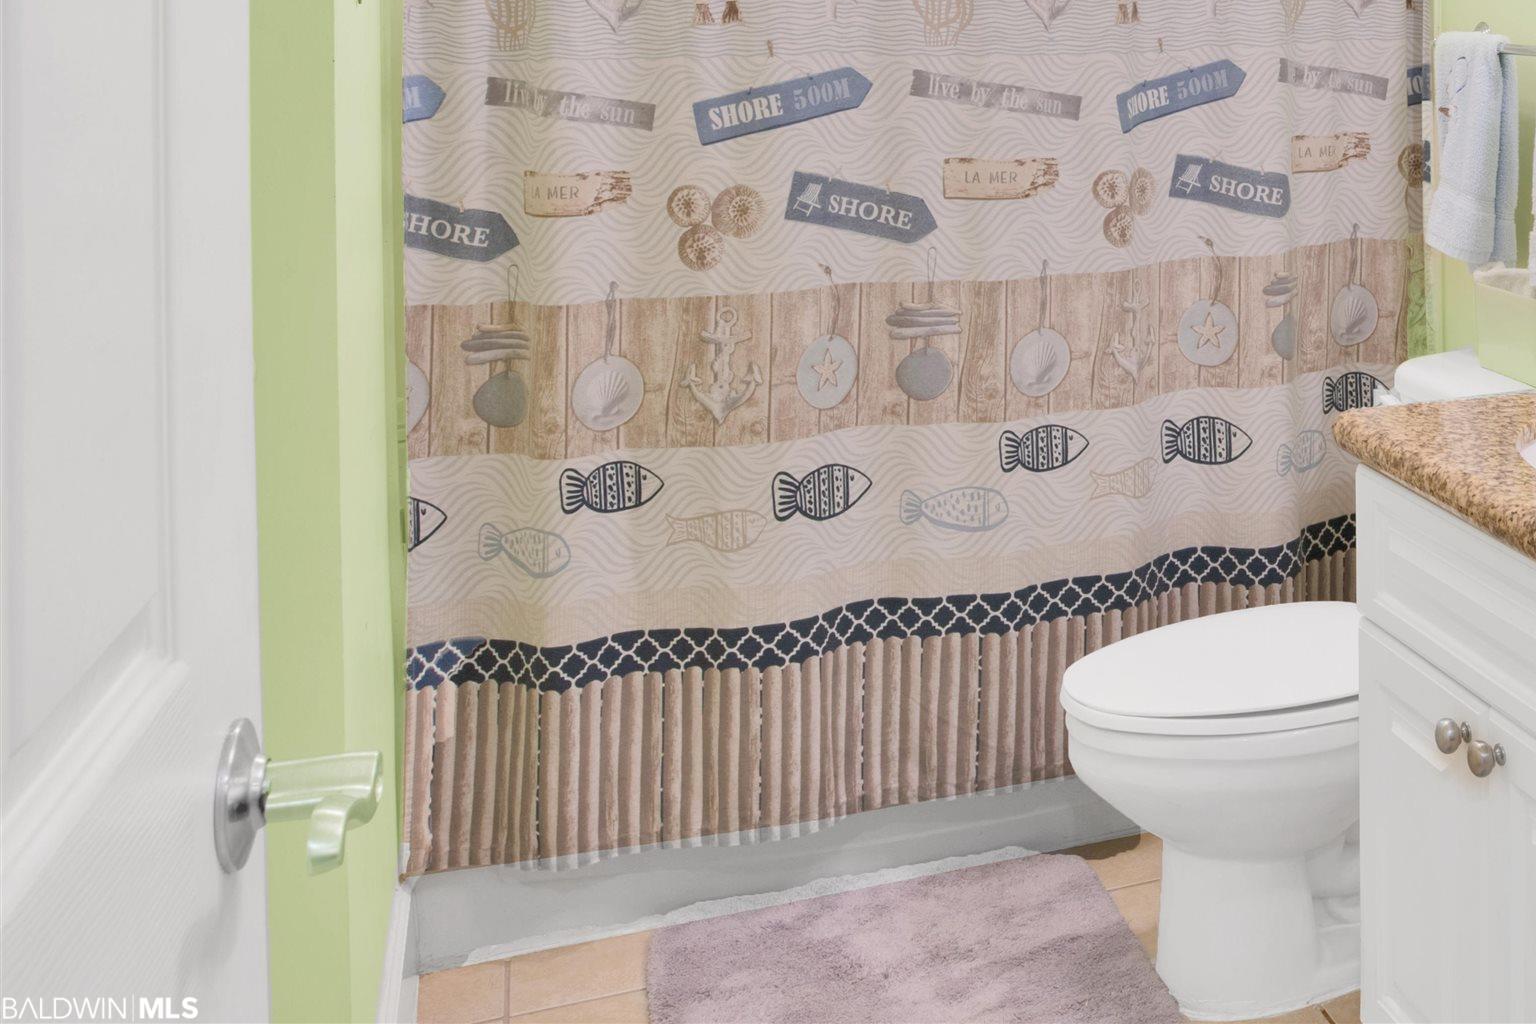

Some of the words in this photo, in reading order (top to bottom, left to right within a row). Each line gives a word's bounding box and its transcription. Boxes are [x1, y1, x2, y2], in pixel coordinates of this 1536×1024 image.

[927, 74, 961, 99] live
[970, 81, 991, 107] by
[1001, 86, 1029, 111] the
[1036, 96, 1063, 115] sun
[1176, 68, 1229, 100] 500M
[559, 94, 592, 120] the
[600, 98, 636, 125] sun
[707, 93, 784, 131] SHORE
[792, 77, 852, 111] 500M
[1298, 146, 1313, 159] LA
[547, 185, 580, 200] MER
[964, 170, 981, 184] LA
[989, 170, 1019, 185] MER
[1208, 174, 1285, 206] SHORE
[828, 193, 914, 231] SHORE
[405, 212, 491, 248] HORE
